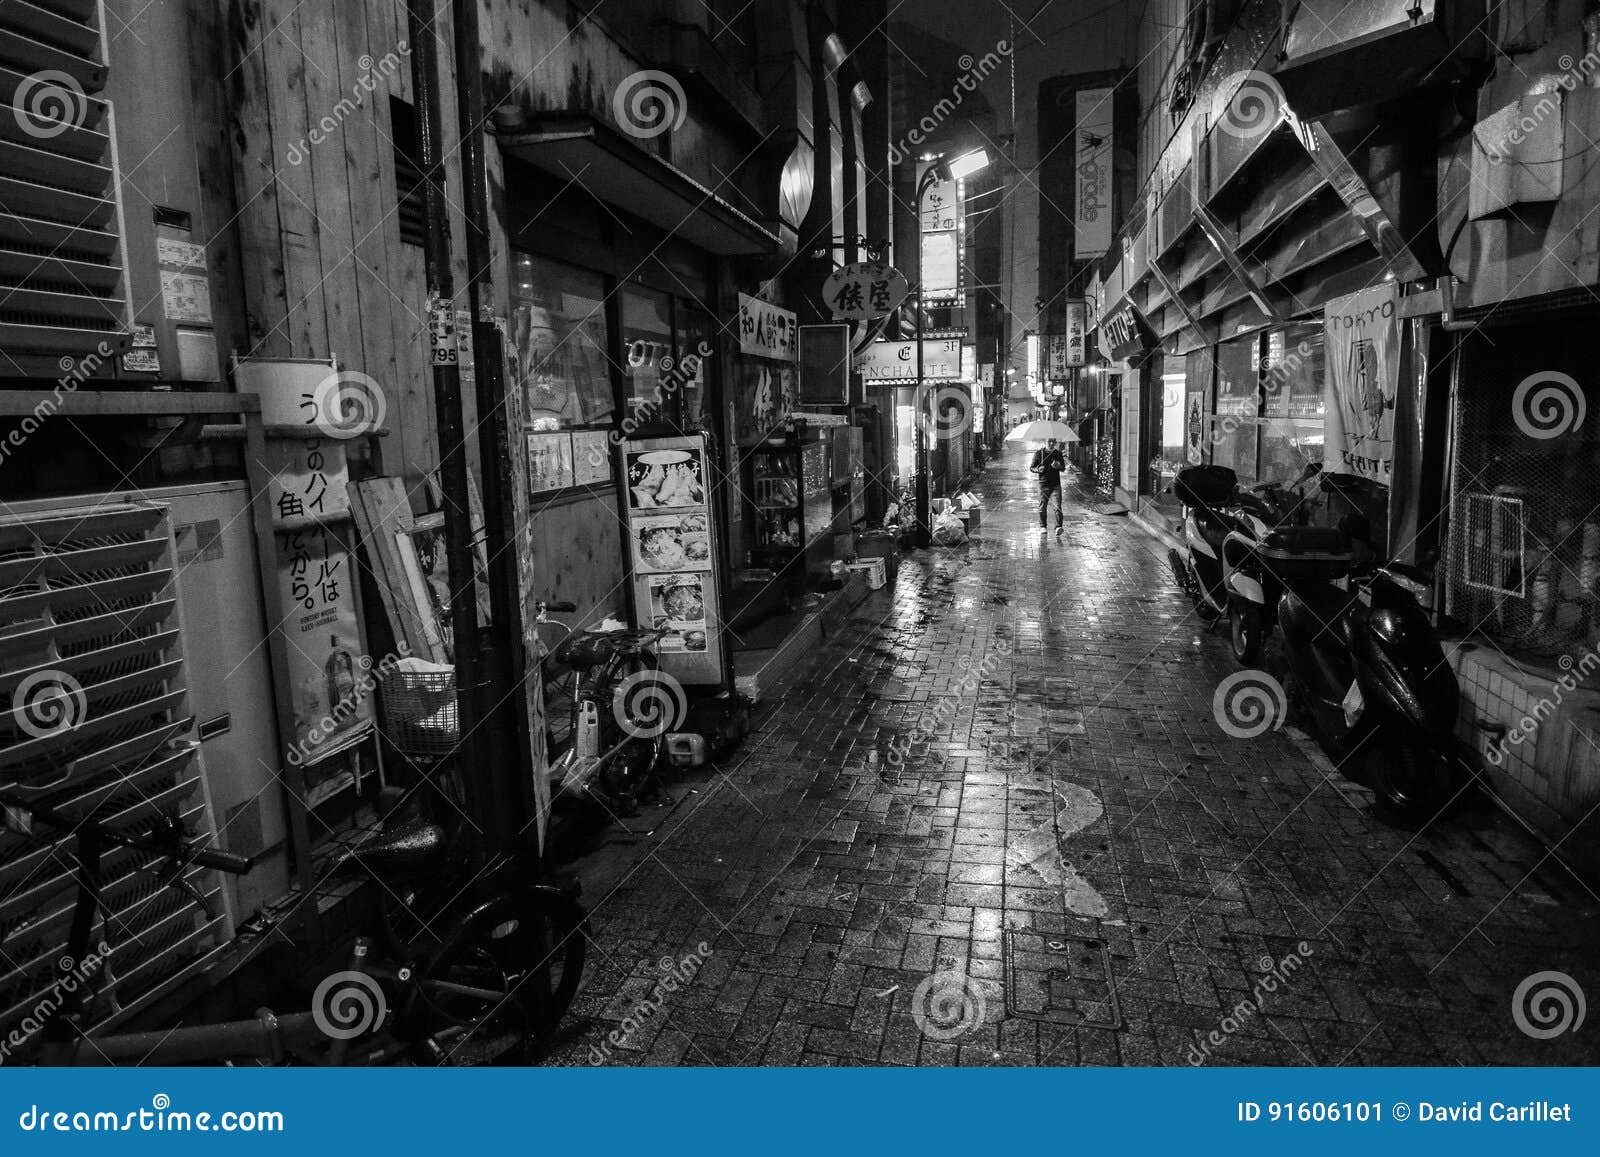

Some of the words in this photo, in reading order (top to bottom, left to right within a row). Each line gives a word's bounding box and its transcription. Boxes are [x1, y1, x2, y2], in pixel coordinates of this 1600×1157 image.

[1330, 300, 1395, 330] TOKYO
[943, 341, 959, 353] 3F
[858, 362, 948, 378] ENCHATE
